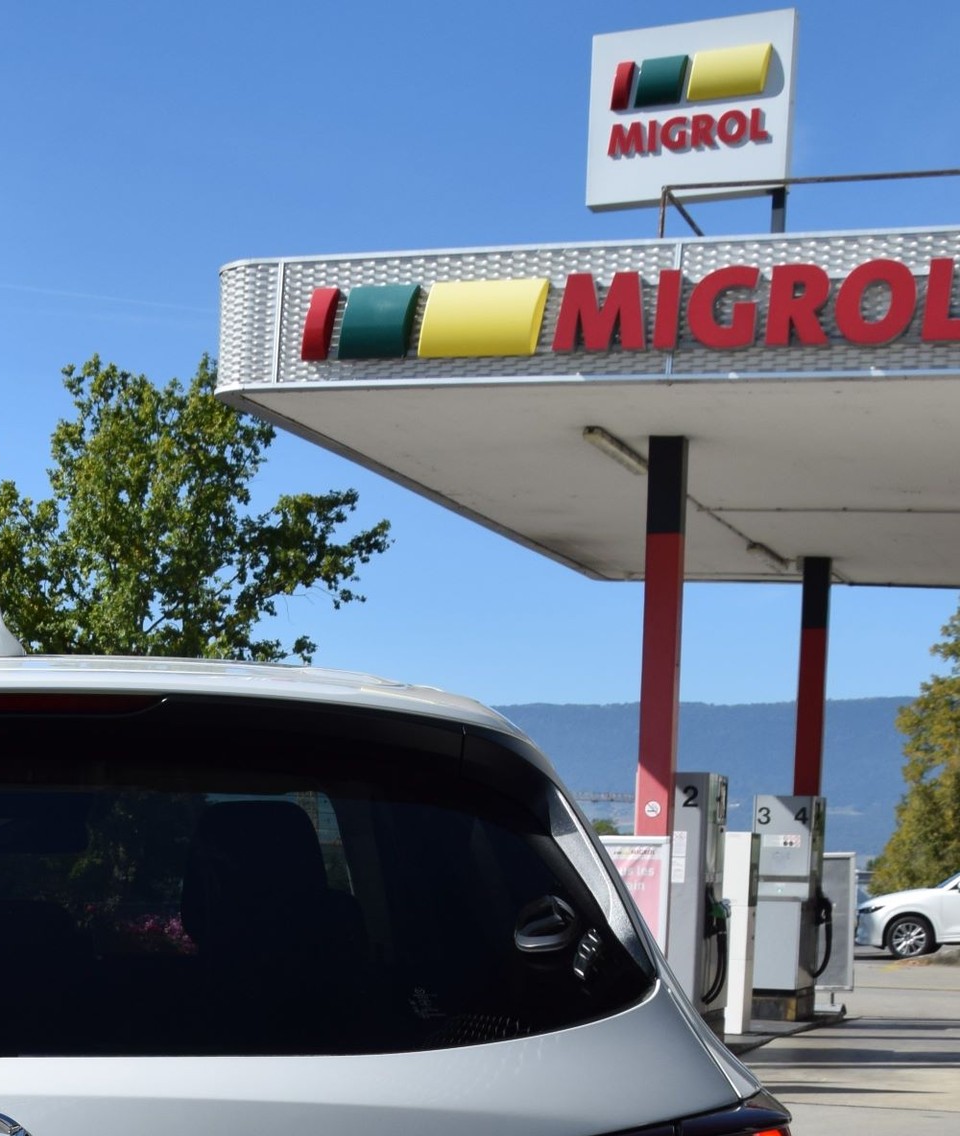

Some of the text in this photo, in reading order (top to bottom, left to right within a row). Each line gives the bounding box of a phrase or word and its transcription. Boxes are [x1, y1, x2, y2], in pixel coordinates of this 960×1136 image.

[608, 108, 768, 156] MIGROL
[552, 257, 960, 351] MIGROL
[682, 785, 699, 808] 2
[757, 806, 771, 825] 3
[794, 806, 809, 825] 4
